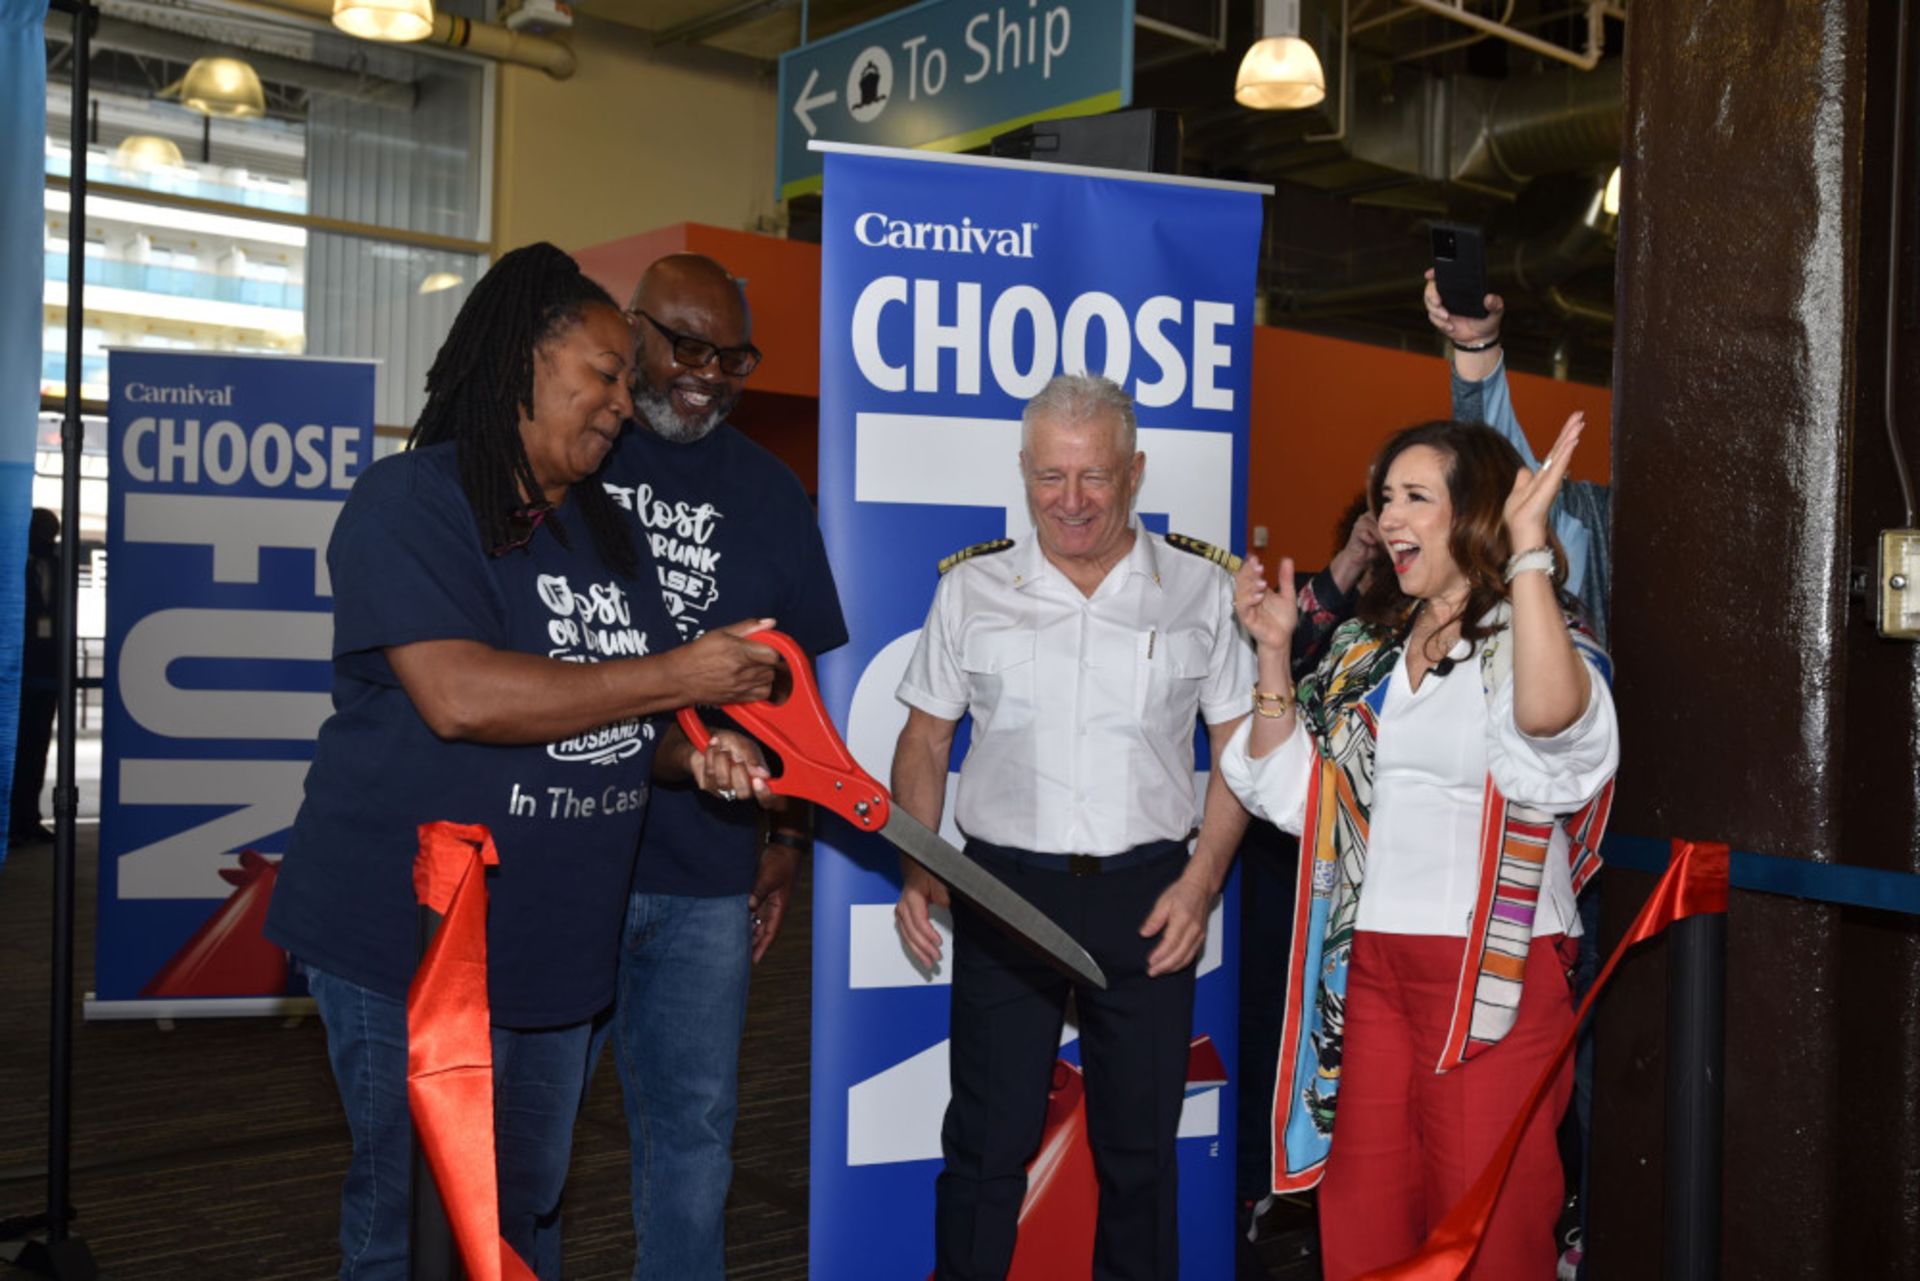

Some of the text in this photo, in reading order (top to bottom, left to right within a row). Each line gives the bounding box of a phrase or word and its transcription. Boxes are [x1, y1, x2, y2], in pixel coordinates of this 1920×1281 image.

[902, 0, 1070, 101] To Ship
[854, 212, 1034, 258] Carnival
[851, 275, 1236, 412] CHOOSE
[124, 382, 233, 406] Carnival
[122, 416, 361, 490] CHOOSE
[645, 532, 721, 573] RUNK
[572, 581, 630, 626] ost
[509, 783, 537, 818] In
[547, 787, 596, 819] The
